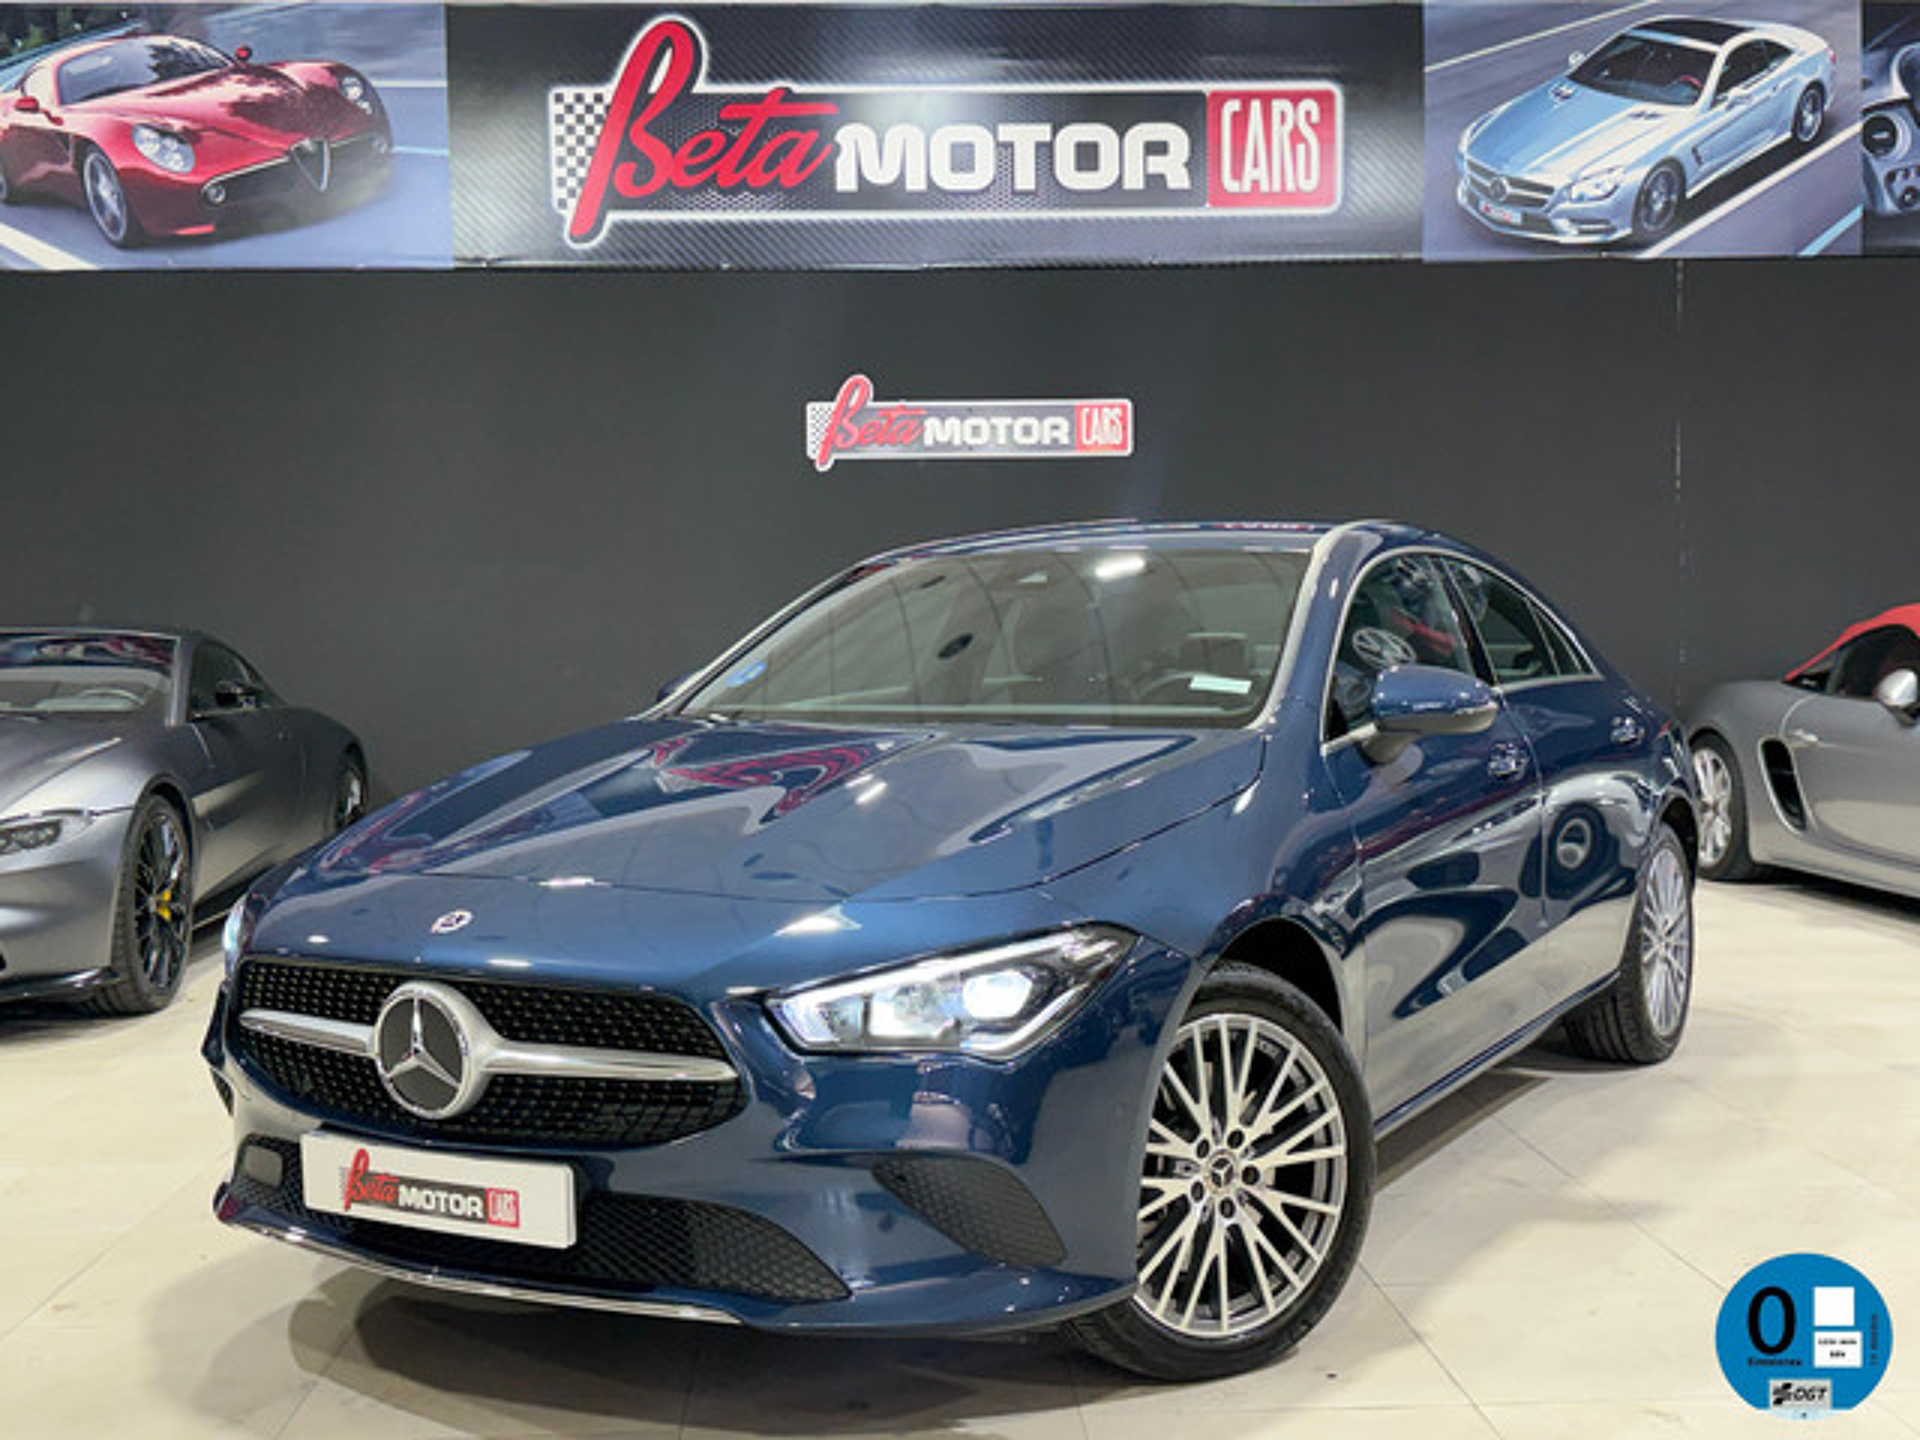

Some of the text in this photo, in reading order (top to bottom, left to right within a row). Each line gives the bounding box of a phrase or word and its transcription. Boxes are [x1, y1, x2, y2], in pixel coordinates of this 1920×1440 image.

[570, 19, 1320, 237] Beta MOTOR CARS
[818, 377, 1123, 465] Beta MOTOR CARS
[344, 1148, 399, 1211] Beta
[398, 1184, 484, 1219] MOTOR
